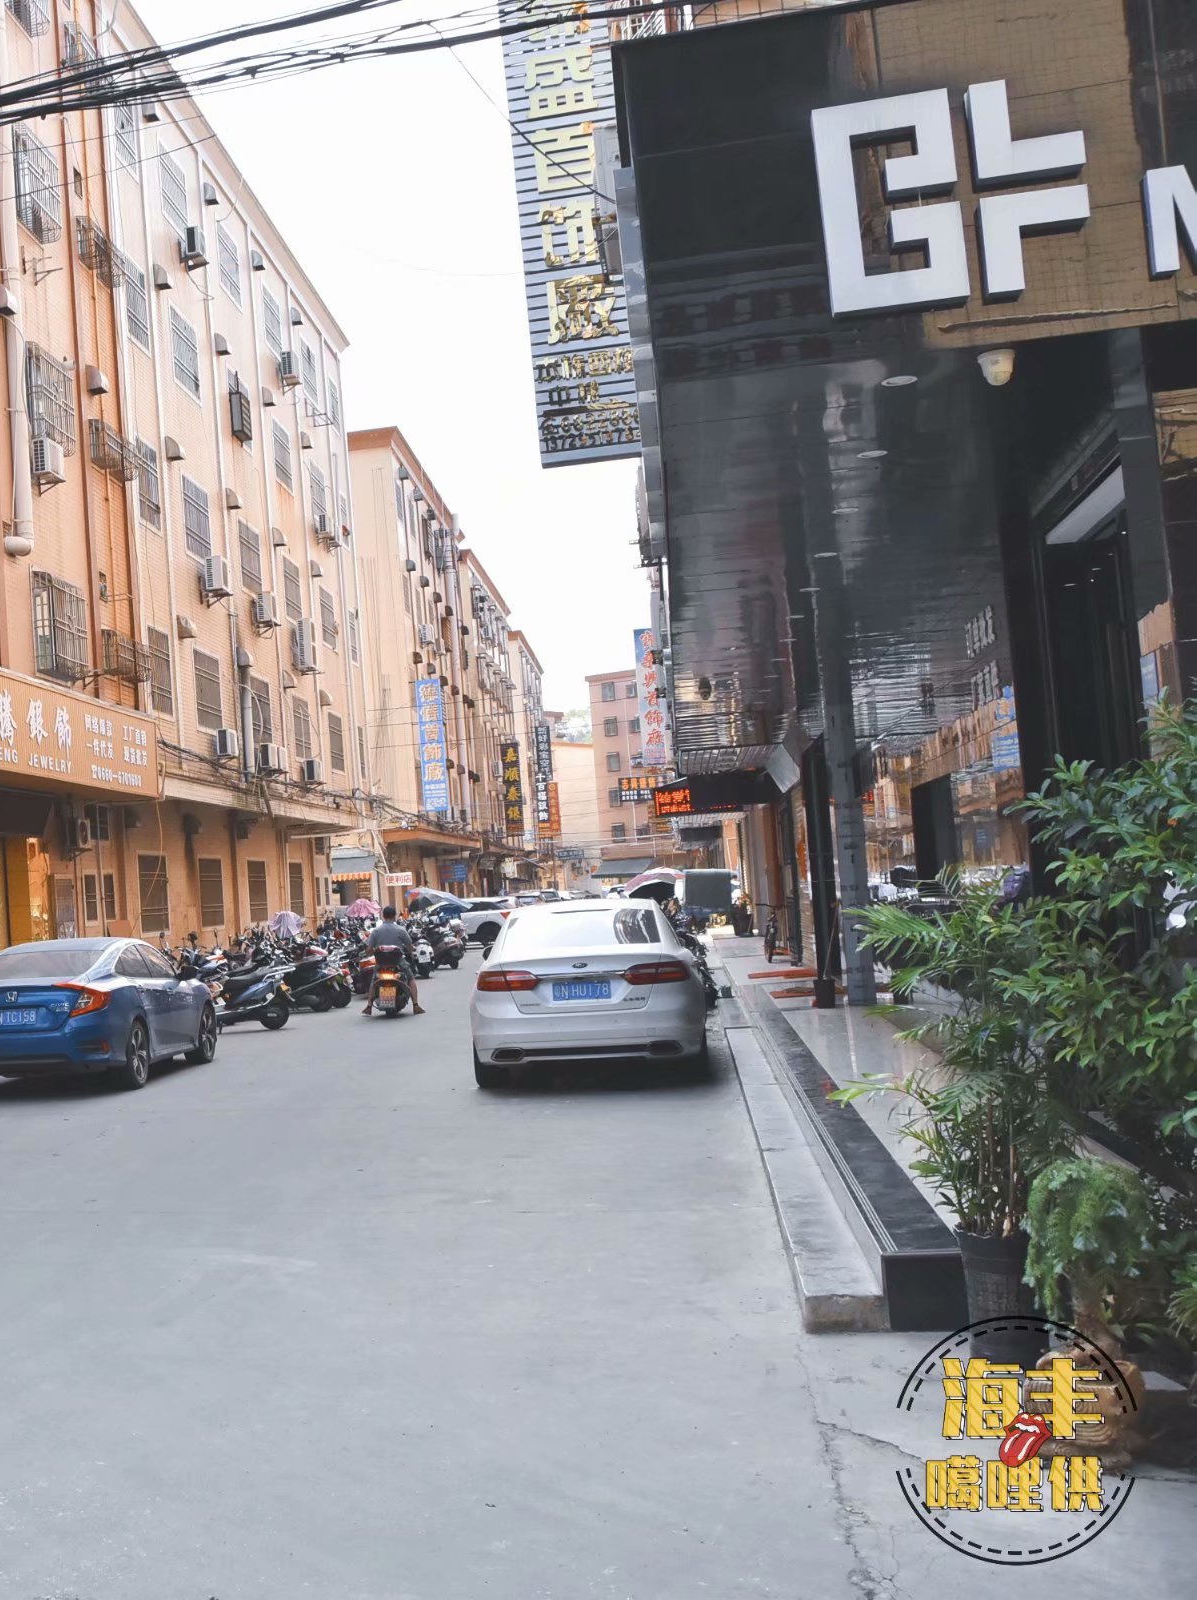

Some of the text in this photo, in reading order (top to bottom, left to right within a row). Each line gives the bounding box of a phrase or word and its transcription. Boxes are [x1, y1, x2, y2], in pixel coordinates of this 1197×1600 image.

[123, 725, 148, 748] 工厂直销
[86, 738, 115, 761] 一件代发
[27, 752, 73, 775] JEWELRY
[386, 874, 412, 884] 便利店
